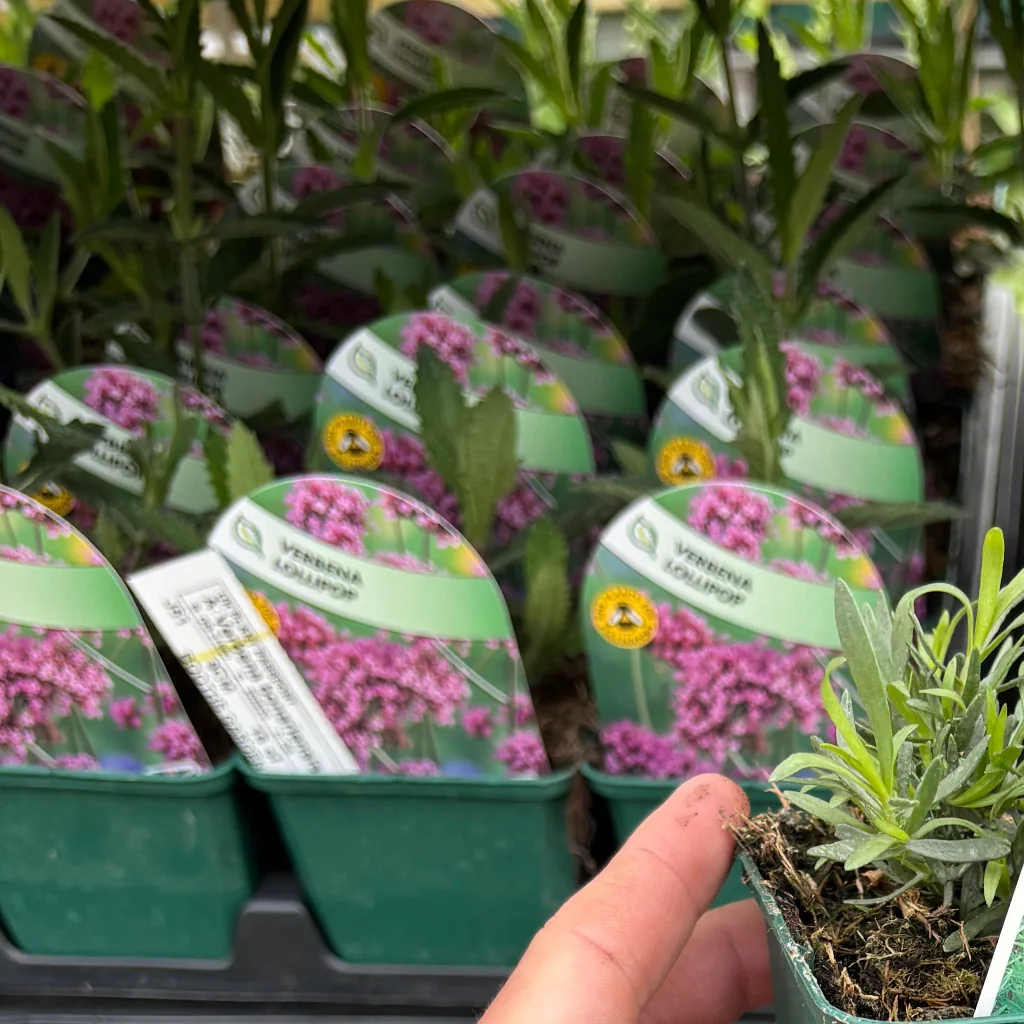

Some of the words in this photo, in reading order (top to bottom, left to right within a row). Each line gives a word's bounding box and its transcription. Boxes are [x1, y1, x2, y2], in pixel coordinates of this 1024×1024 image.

[273, 556, 359, 602] LOLLIPOP
[280, 537, 364, 589] VERBENA
[663, 558, 746, 607] LOLLIPOP
[674, 539, 753, 594] VERBENA
